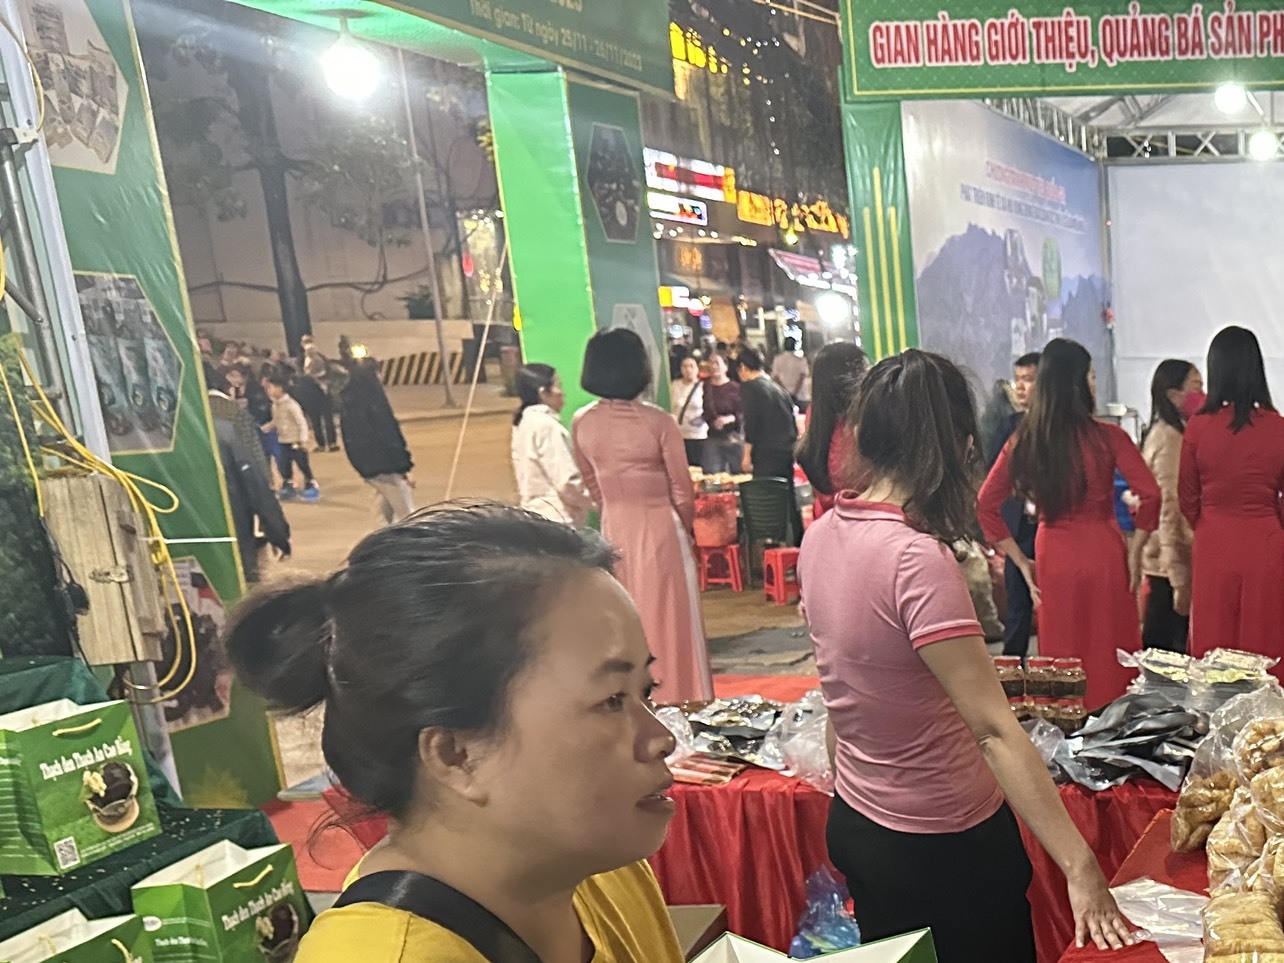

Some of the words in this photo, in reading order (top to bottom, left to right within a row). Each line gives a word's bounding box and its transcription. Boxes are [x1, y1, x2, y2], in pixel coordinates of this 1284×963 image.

[871, 22, 921, 66] GIAN
[925, 12, 983, 65] HÀNG
[985, 10, 1029, 64] GIỚI
[1031, 8, 1098, 71] THIỆU,
[1100, 3, 1171, 66] QUẢNG
[1175, 5, 1207, 59] BÁ
[1209, 1, 1254, 59] SẢN
